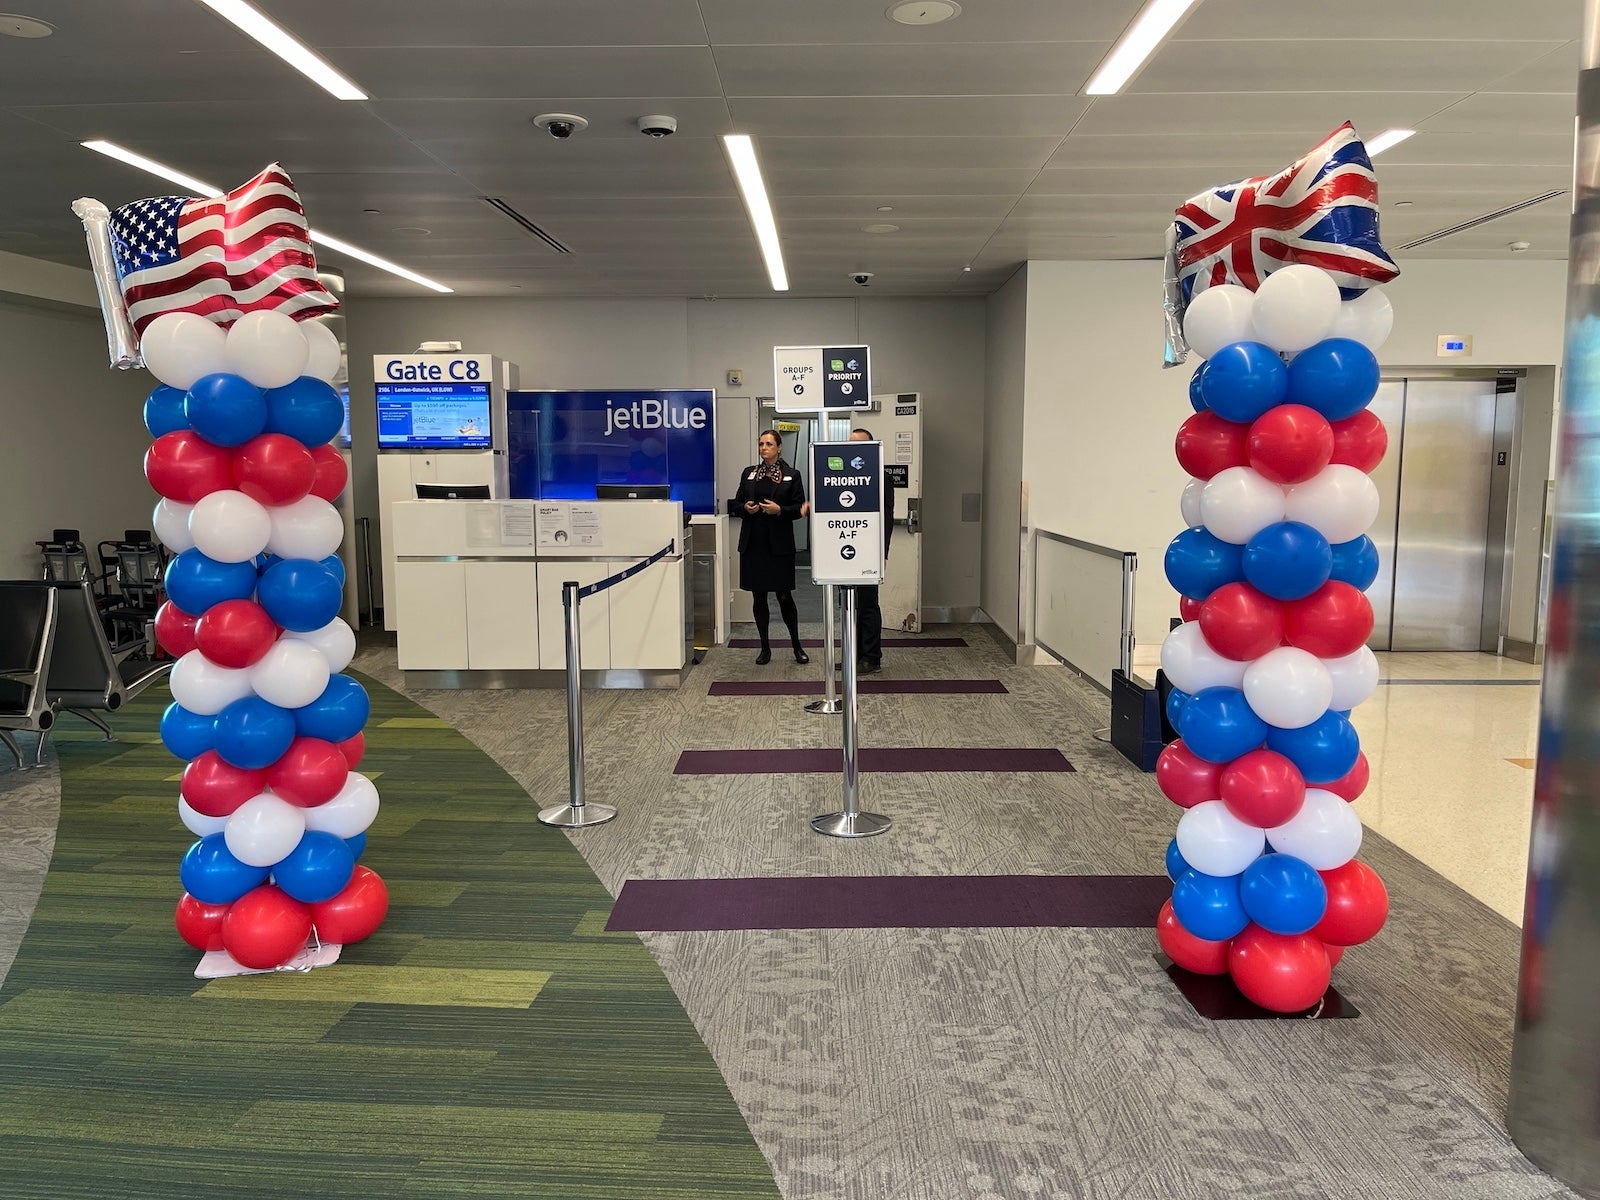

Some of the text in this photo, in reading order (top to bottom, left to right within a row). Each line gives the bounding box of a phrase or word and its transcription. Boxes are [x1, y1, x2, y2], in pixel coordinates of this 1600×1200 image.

[386, 360, 480, 380] Gate C8
[783, 366, 814, 374] GROUPS
[828, 372, 862, 380] PRIORITY
[413, 416, 436, 424] jetBlue
[604, 400, 706, 436] jetBlue
[824, 476, 872, 486] PRIORITY
[828, 519, 868, 529] GROUPS
[839, 531, 857, 539] A-F
